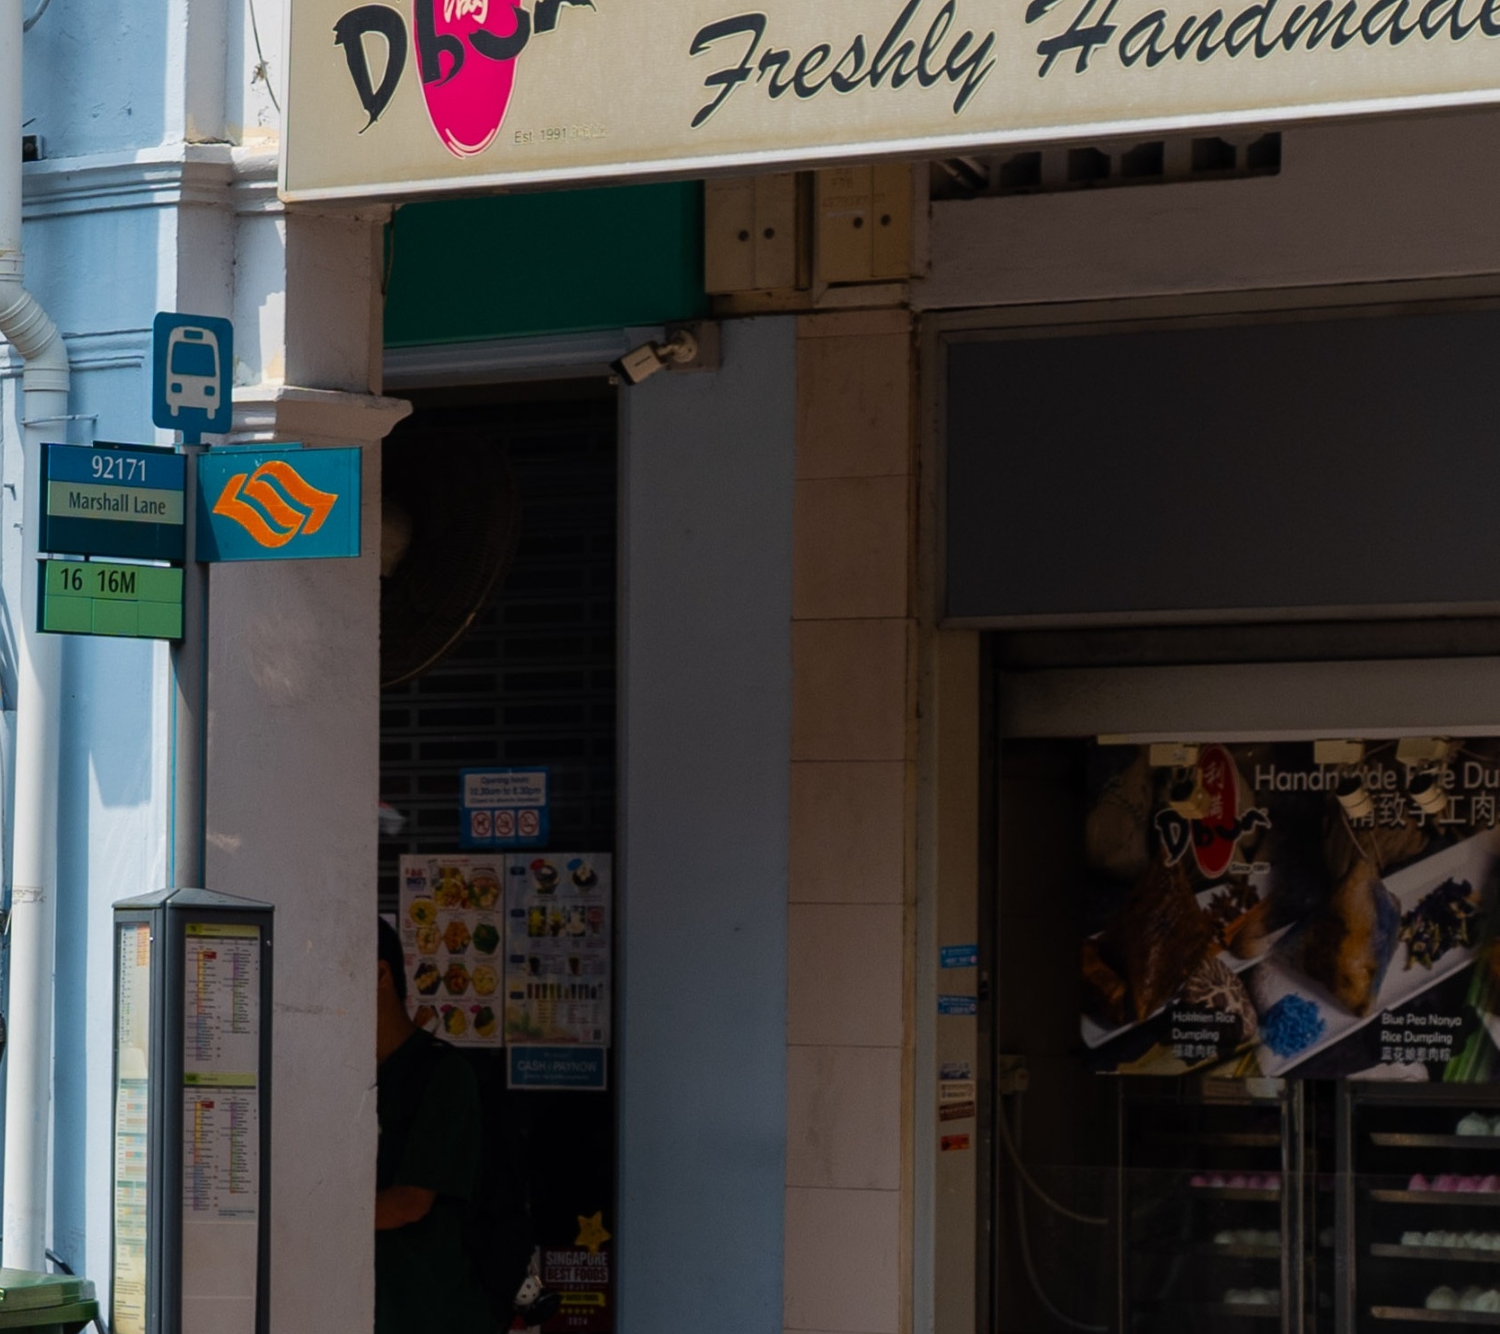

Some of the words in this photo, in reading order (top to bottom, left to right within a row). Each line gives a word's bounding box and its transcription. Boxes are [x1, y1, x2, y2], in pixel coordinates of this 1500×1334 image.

[540, 127, 567, 141] 1991
[91, 455, 146, 482] 92171
[68, 491, 129, 514] Marshall
[134, 495, 166, 515] Lane
[61, 568, 83, 591] 16
[97, 569, 136, 594] 16M
[1172, 1011, 1214, 1024] Hokkien
[1215, 1012, 1236, 1024] Rice
[1381, 1012, 1404, 1025] Blue
[1407, 1013, 1427, 1025] Pea
[1429, 1014, 1462, 1028] Nonya
[1172, 1028, 1220, 1042] Dumpling
[1381, 1030, 1402, 1043] Rice
[1404, 1030, 1453, 1045] Dumpling
[517, 1059, 546, 1072] CASH
[547, 1268, 572, 1281] BEST
[574, 1267, 608, 1281] FOODS
